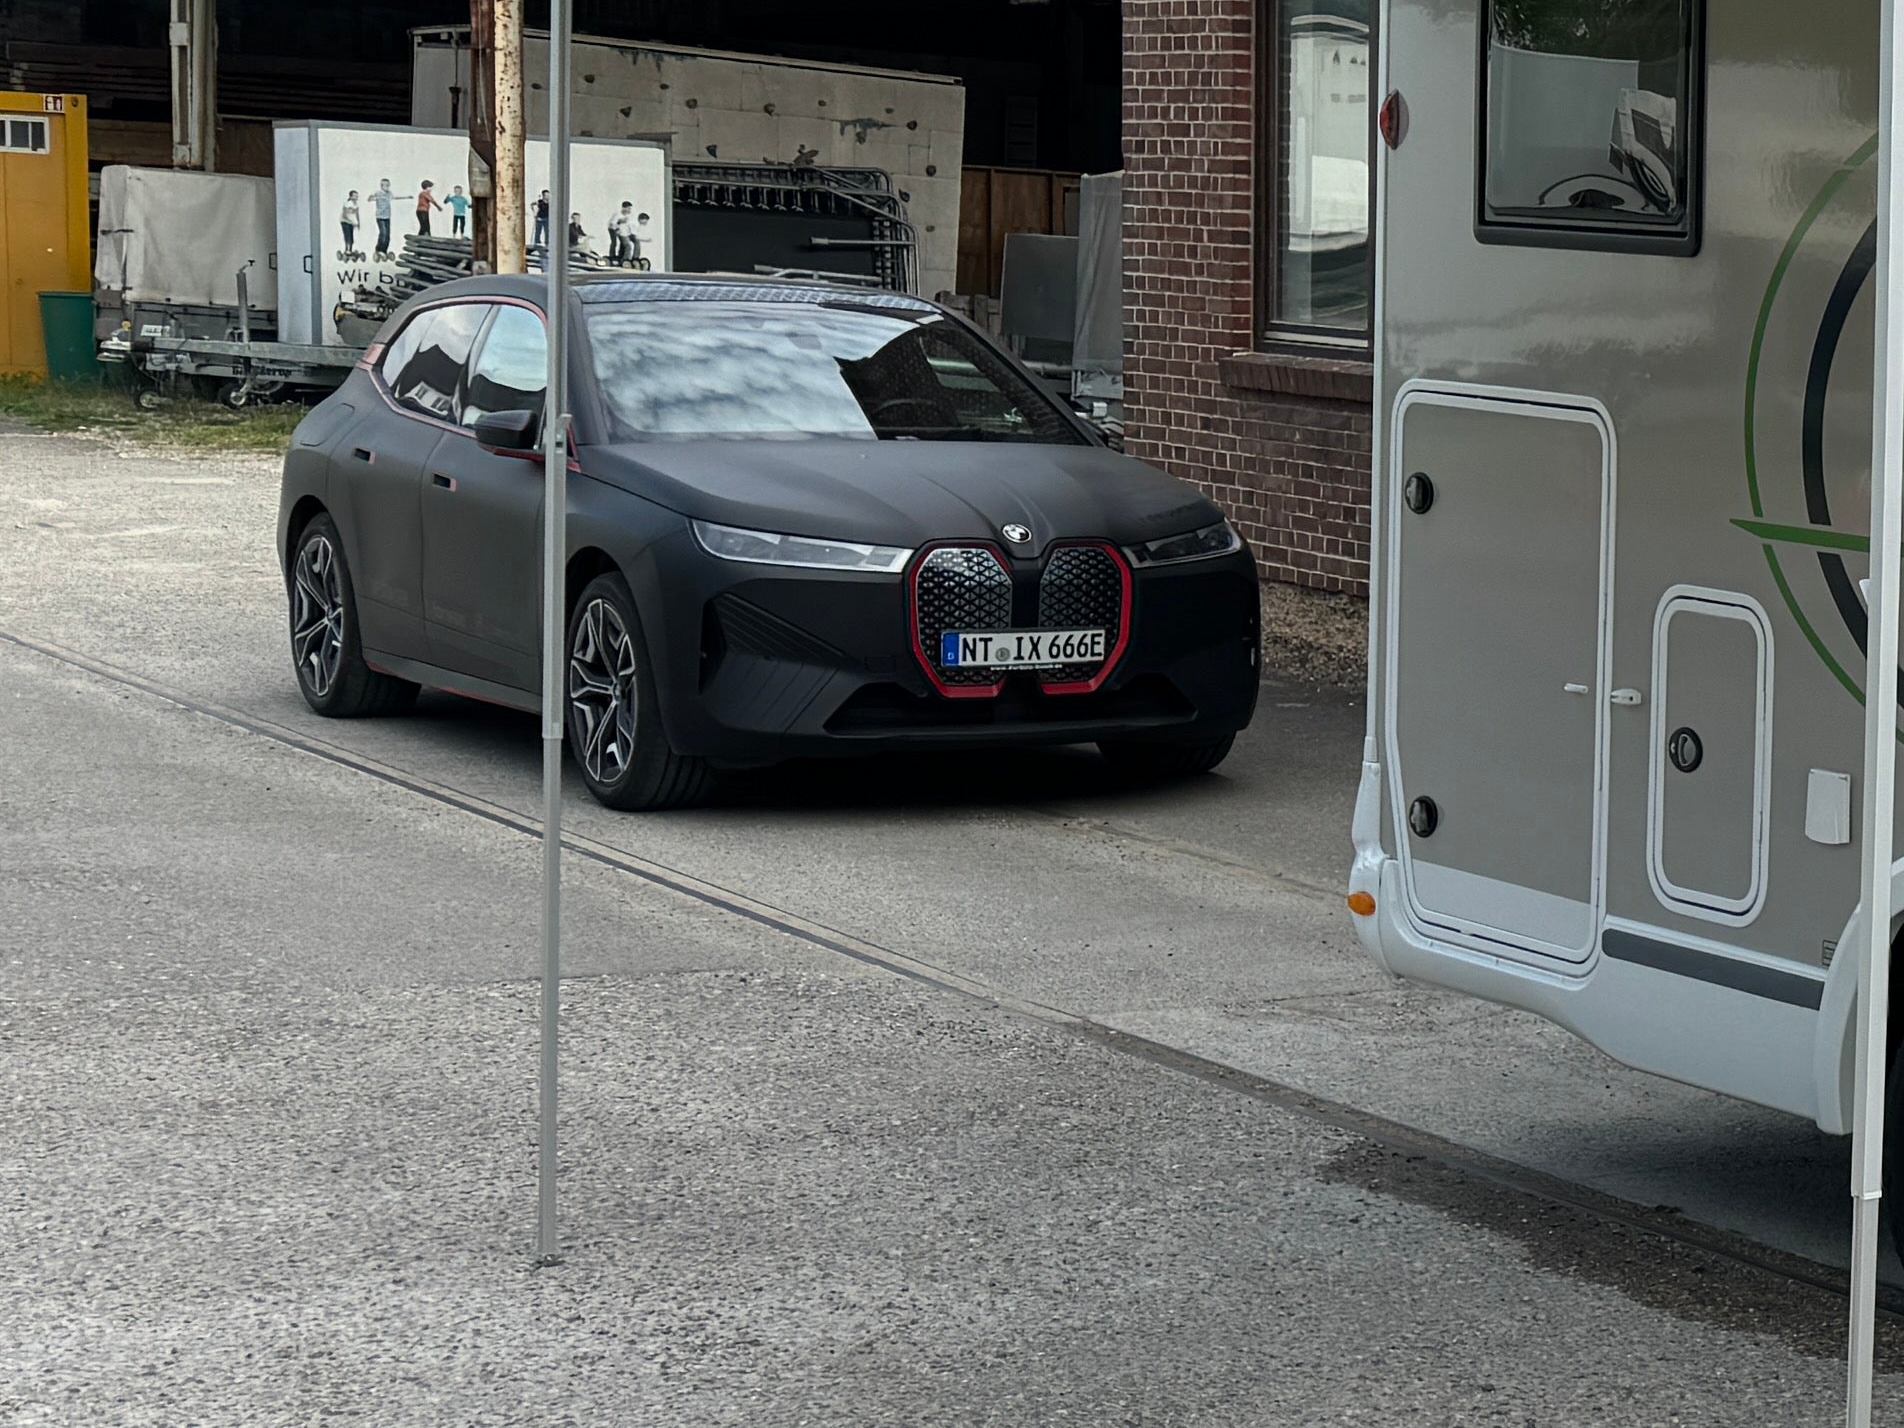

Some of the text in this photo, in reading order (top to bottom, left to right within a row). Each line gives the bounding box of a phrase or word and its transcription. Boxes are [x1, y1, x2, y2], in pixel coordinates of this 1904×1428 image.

[337, 269, 370, 284] Wir
[961, 633, 1104, 662] NT IX 666E
